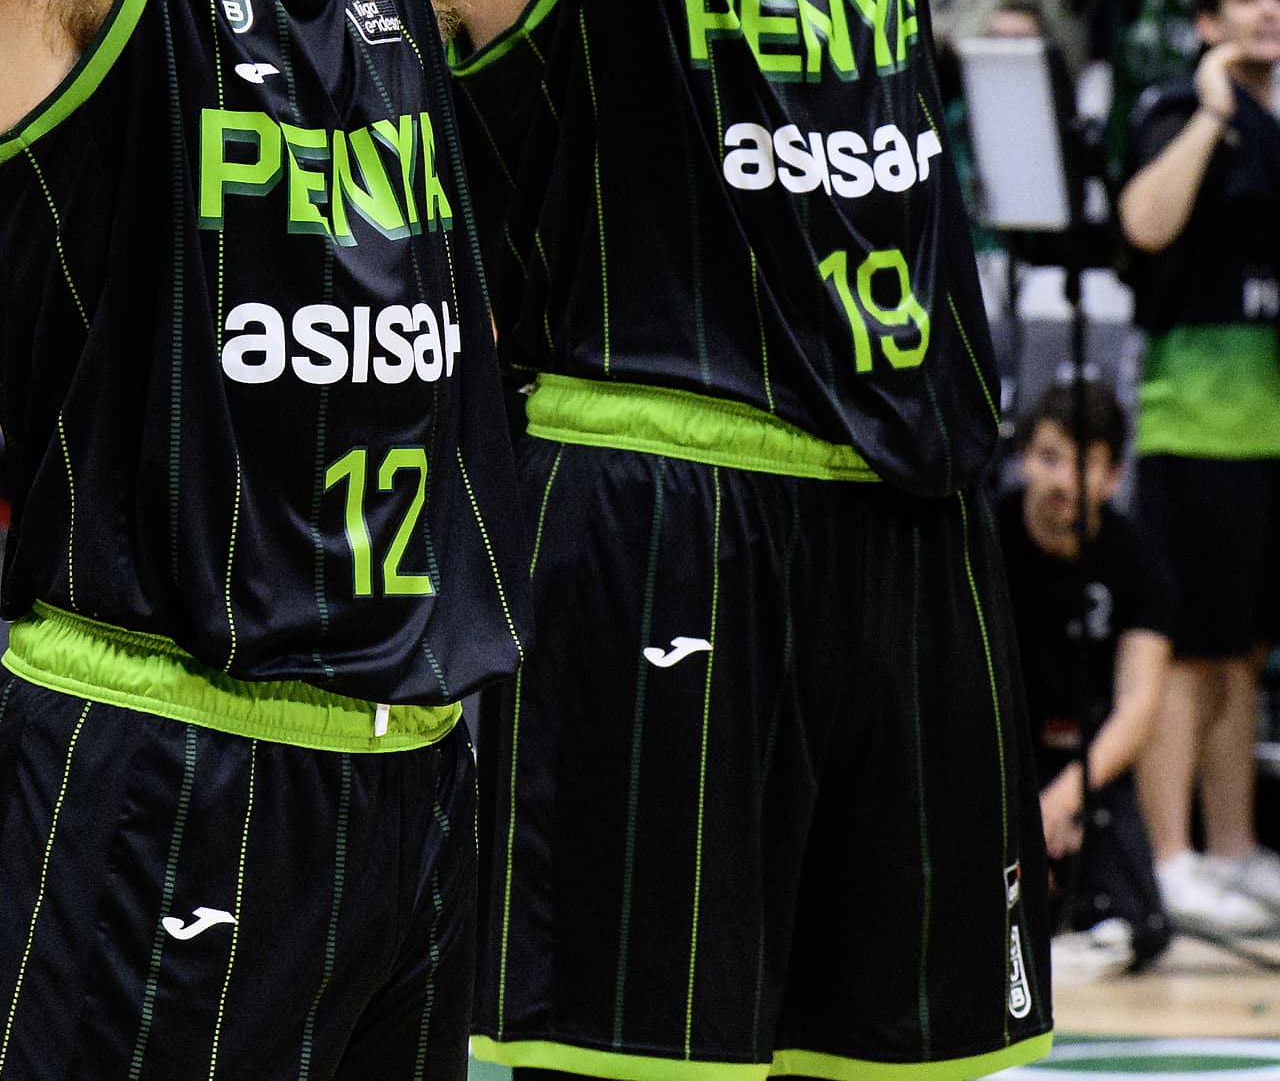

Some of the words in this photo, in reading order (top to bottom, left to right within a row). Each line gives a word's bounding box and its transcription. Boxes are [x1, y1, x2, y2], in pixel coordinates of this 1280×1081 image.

[352, 0, 380, 19] liga
[197, 107, 454, 248] PENYA
[818, 248, 931, 373] 19
[323, 446, 437, 598] 12
